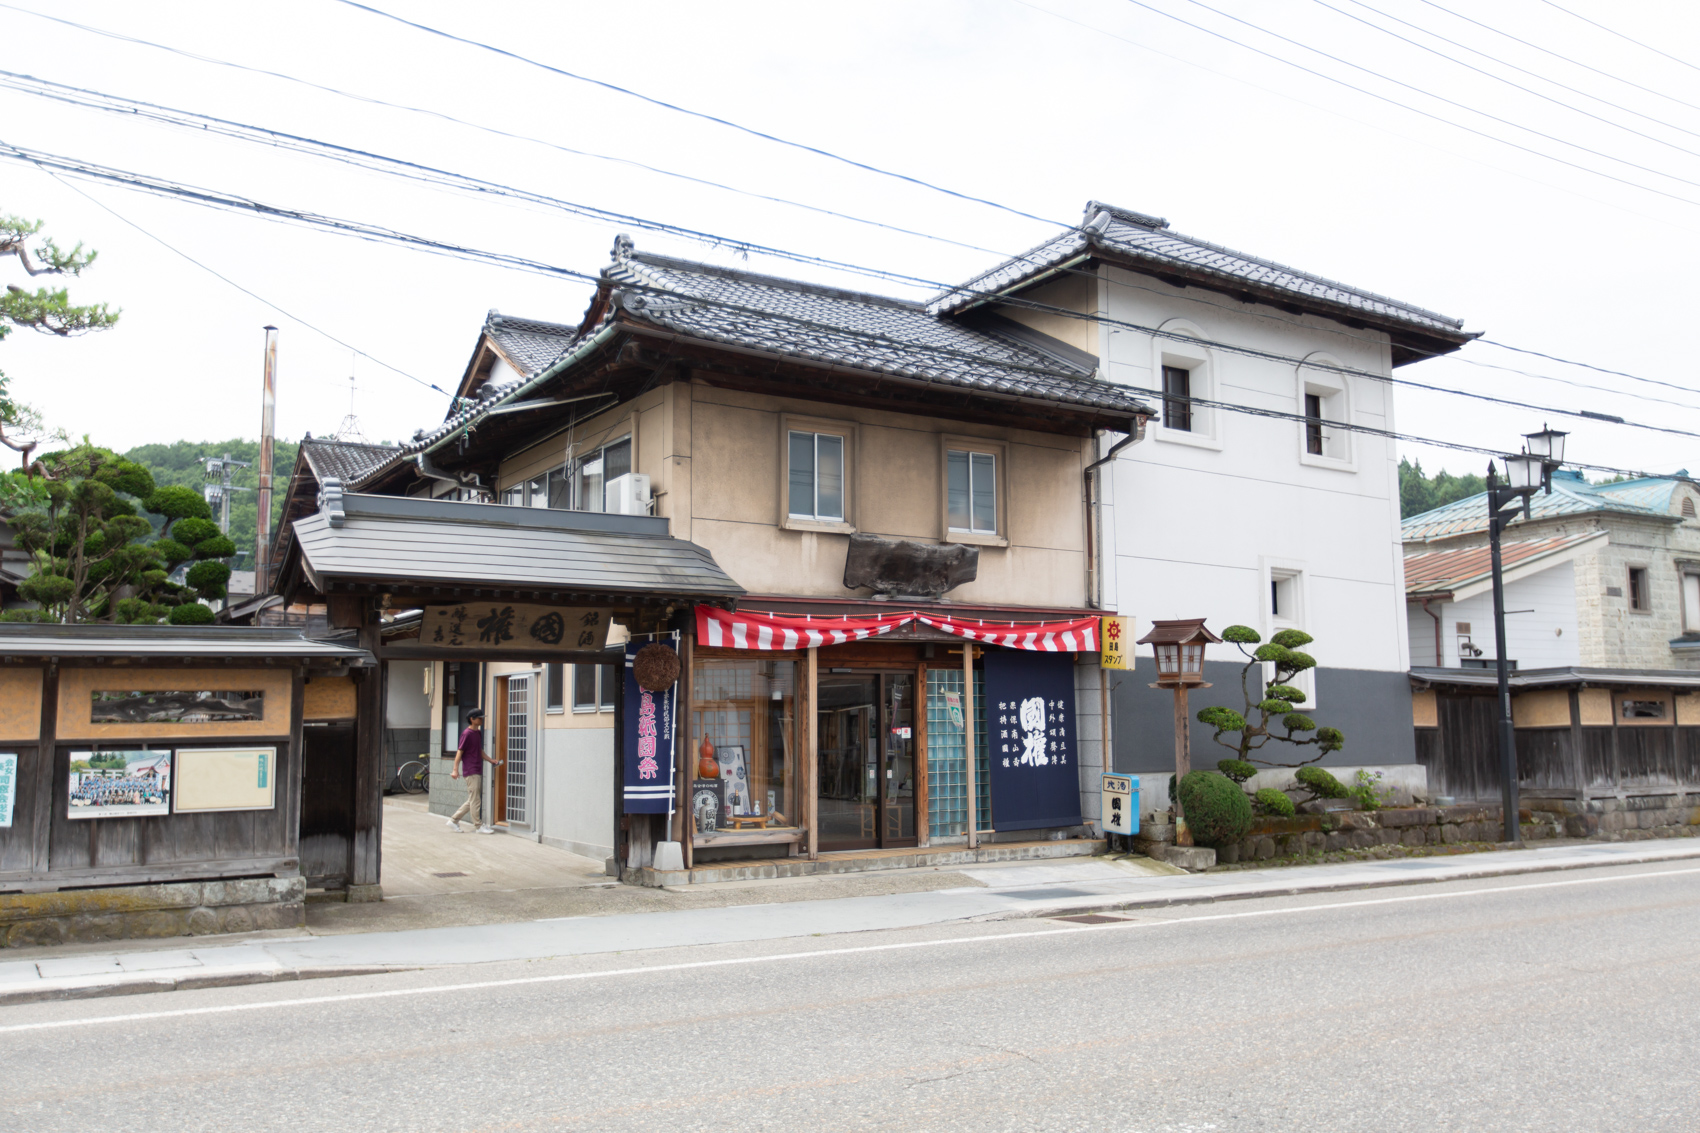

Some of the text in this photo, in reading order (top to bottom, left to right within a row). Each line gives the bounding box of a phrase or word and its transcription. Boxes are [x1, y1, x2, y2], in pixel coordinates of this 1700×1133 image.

[1108, 641, 1119, 652] 田島
[1104, 654, 1123, 664] スタンプ
[638, 685, 658, 779] 島祇園祭
[1106, 780, 1127, 791] 地酒
